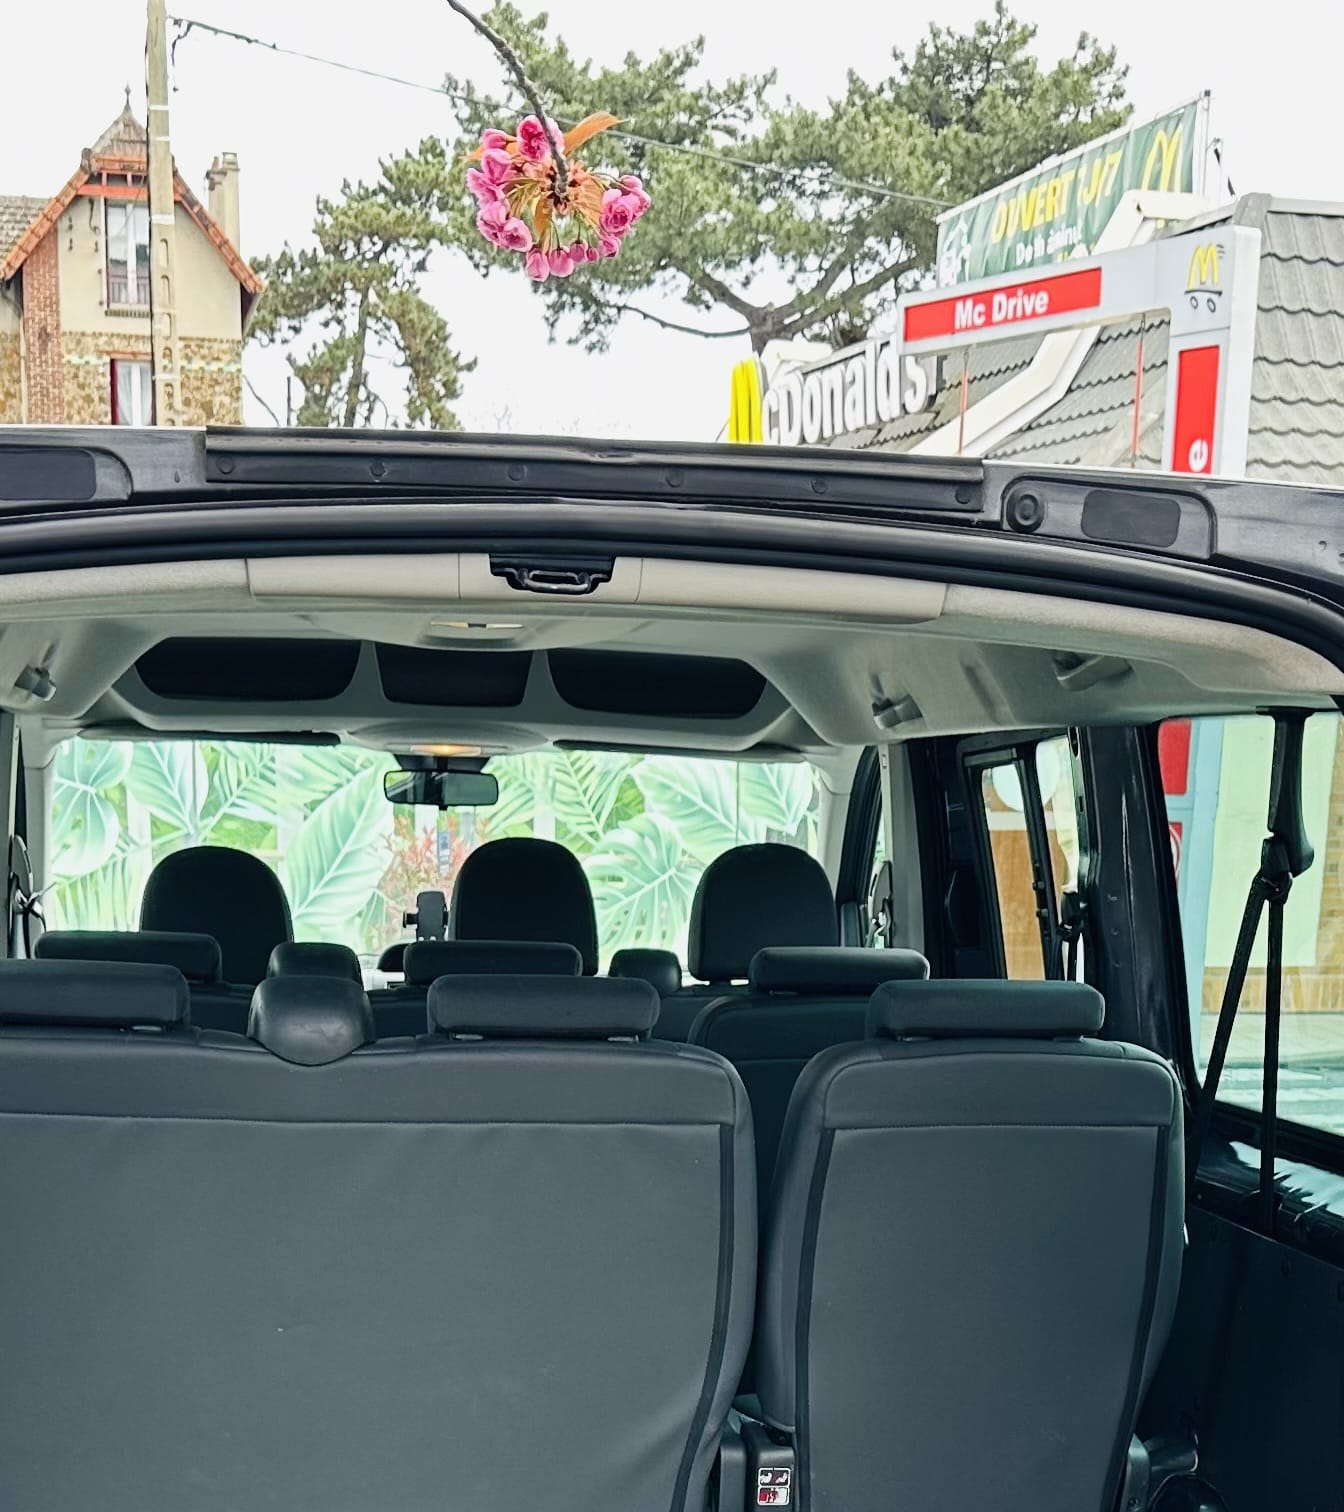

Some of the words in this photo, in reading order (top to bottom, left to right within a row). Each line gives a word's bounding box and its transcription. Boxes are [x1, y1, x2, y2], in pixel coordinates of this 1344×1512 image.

[990, 169, 1077, 244] OUVERT
[954, 298, 986, 330] Mc
[992, 289, 1049, 323] Drive
[728, 328, 927, 446] McDonalds
